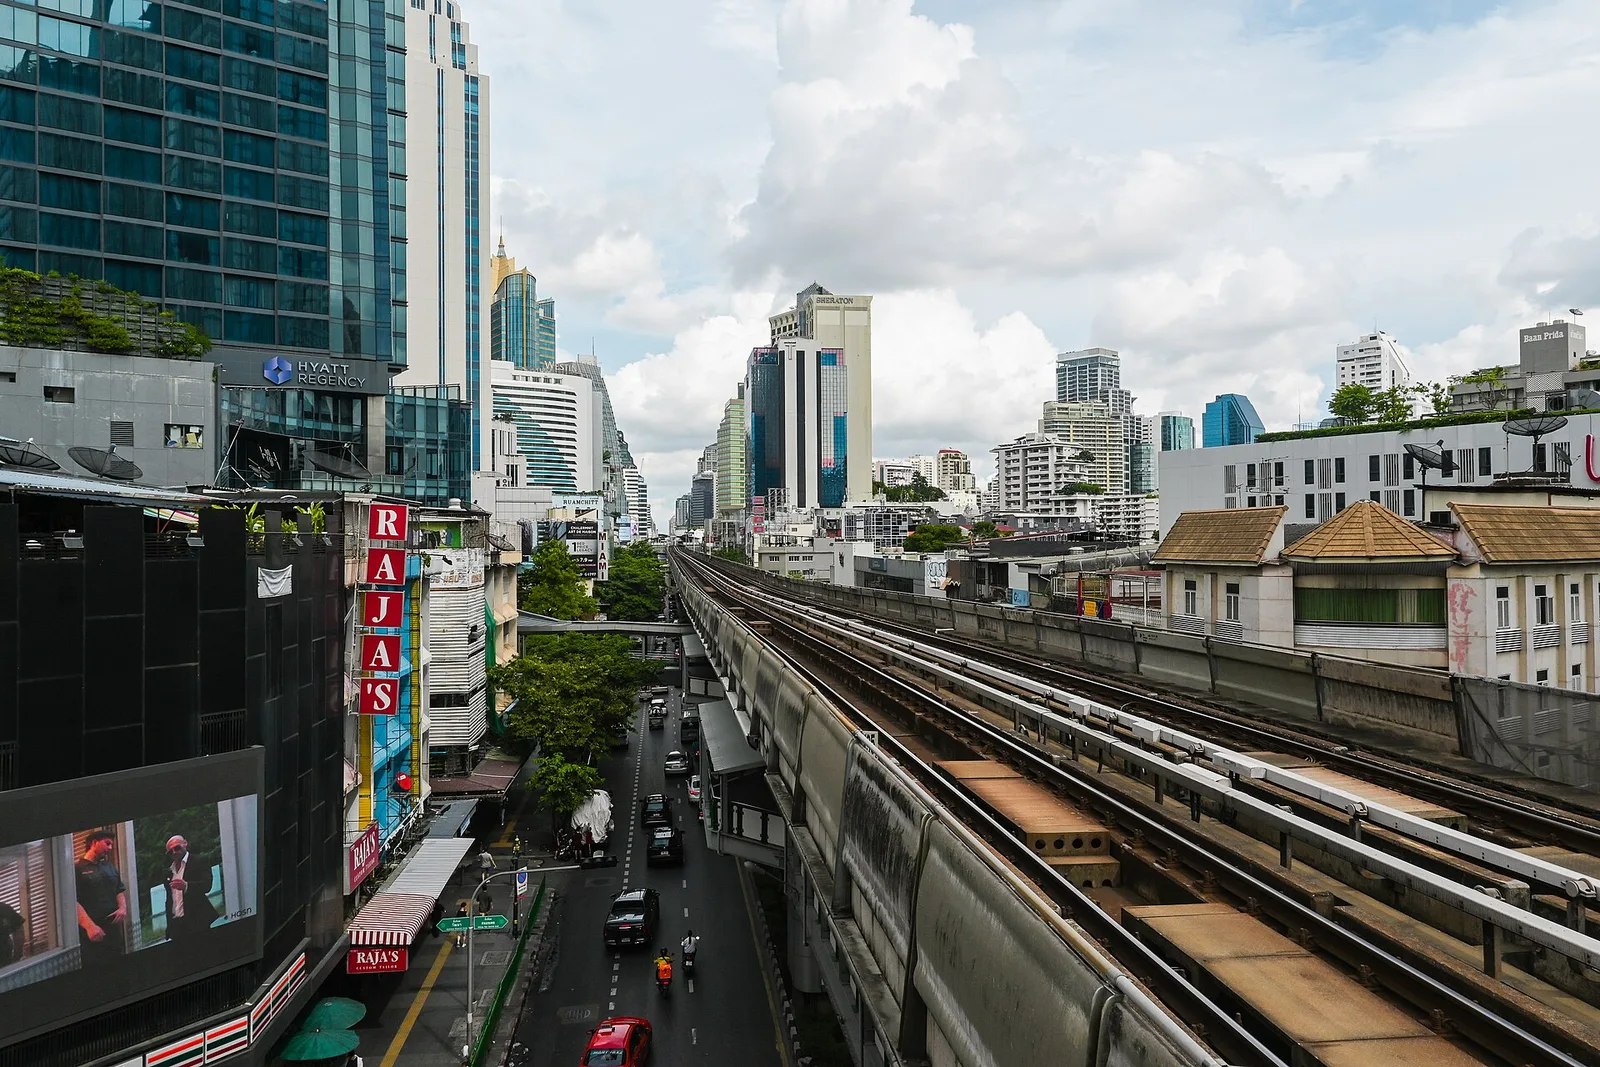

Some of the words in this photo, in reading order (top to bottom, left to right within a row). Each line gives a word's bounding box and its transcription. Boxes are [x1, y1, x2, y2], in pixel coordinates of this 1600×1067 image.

[1524, 334, 1542, 342] Baan
[1544, 330, 1564, 340] Prida
[298, 362, 349, 374] HYATT
[544, 360, 578, 372] WESTIN
[298, 374, 366, 387] REGENCY
[366, 509, 398, 710] RAJA'S
[354, 831, 376, 870] RAJA'S
[356, 950, 399, 965] RAJA'S
